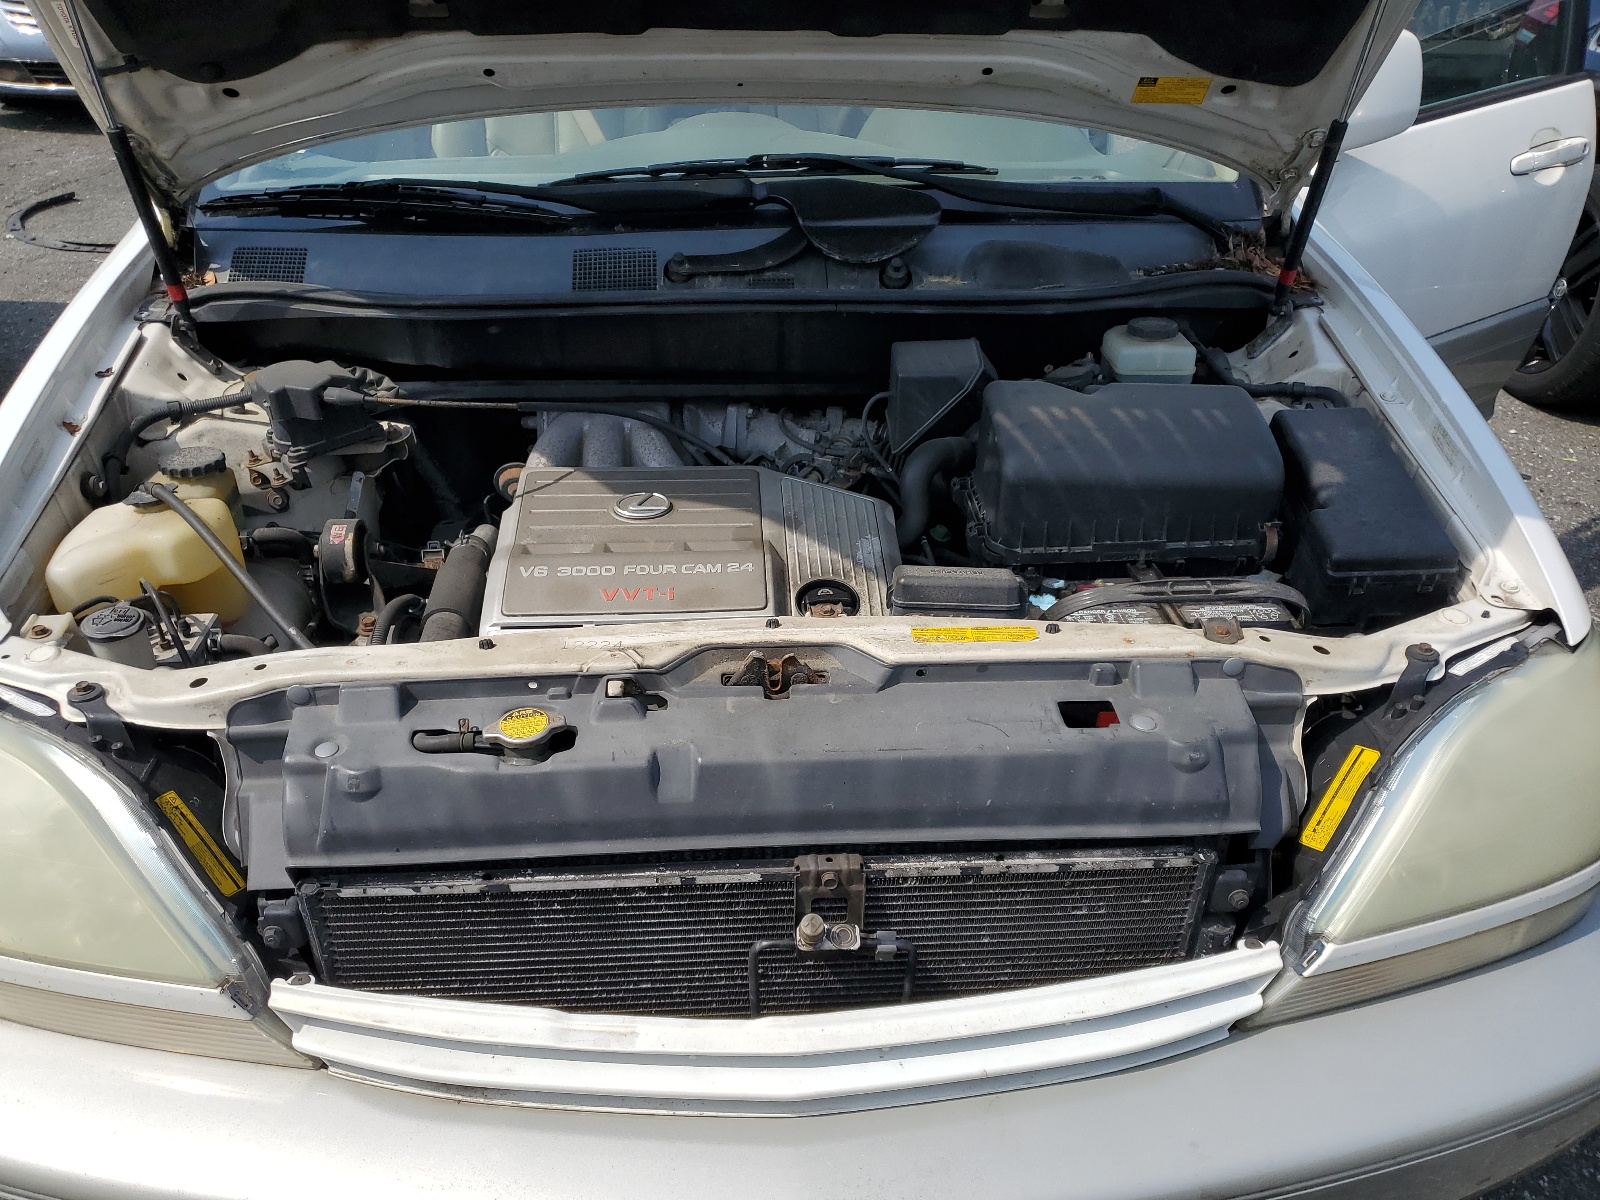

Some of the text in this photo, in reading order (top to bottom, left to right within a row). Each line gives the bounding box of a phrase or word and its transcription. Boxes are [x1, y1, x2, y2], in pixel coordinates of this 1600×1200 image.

[520, 562, 754, 577] V6 3000 FOUR CAM 24
[600, 587, 675, 601] VVT-i
